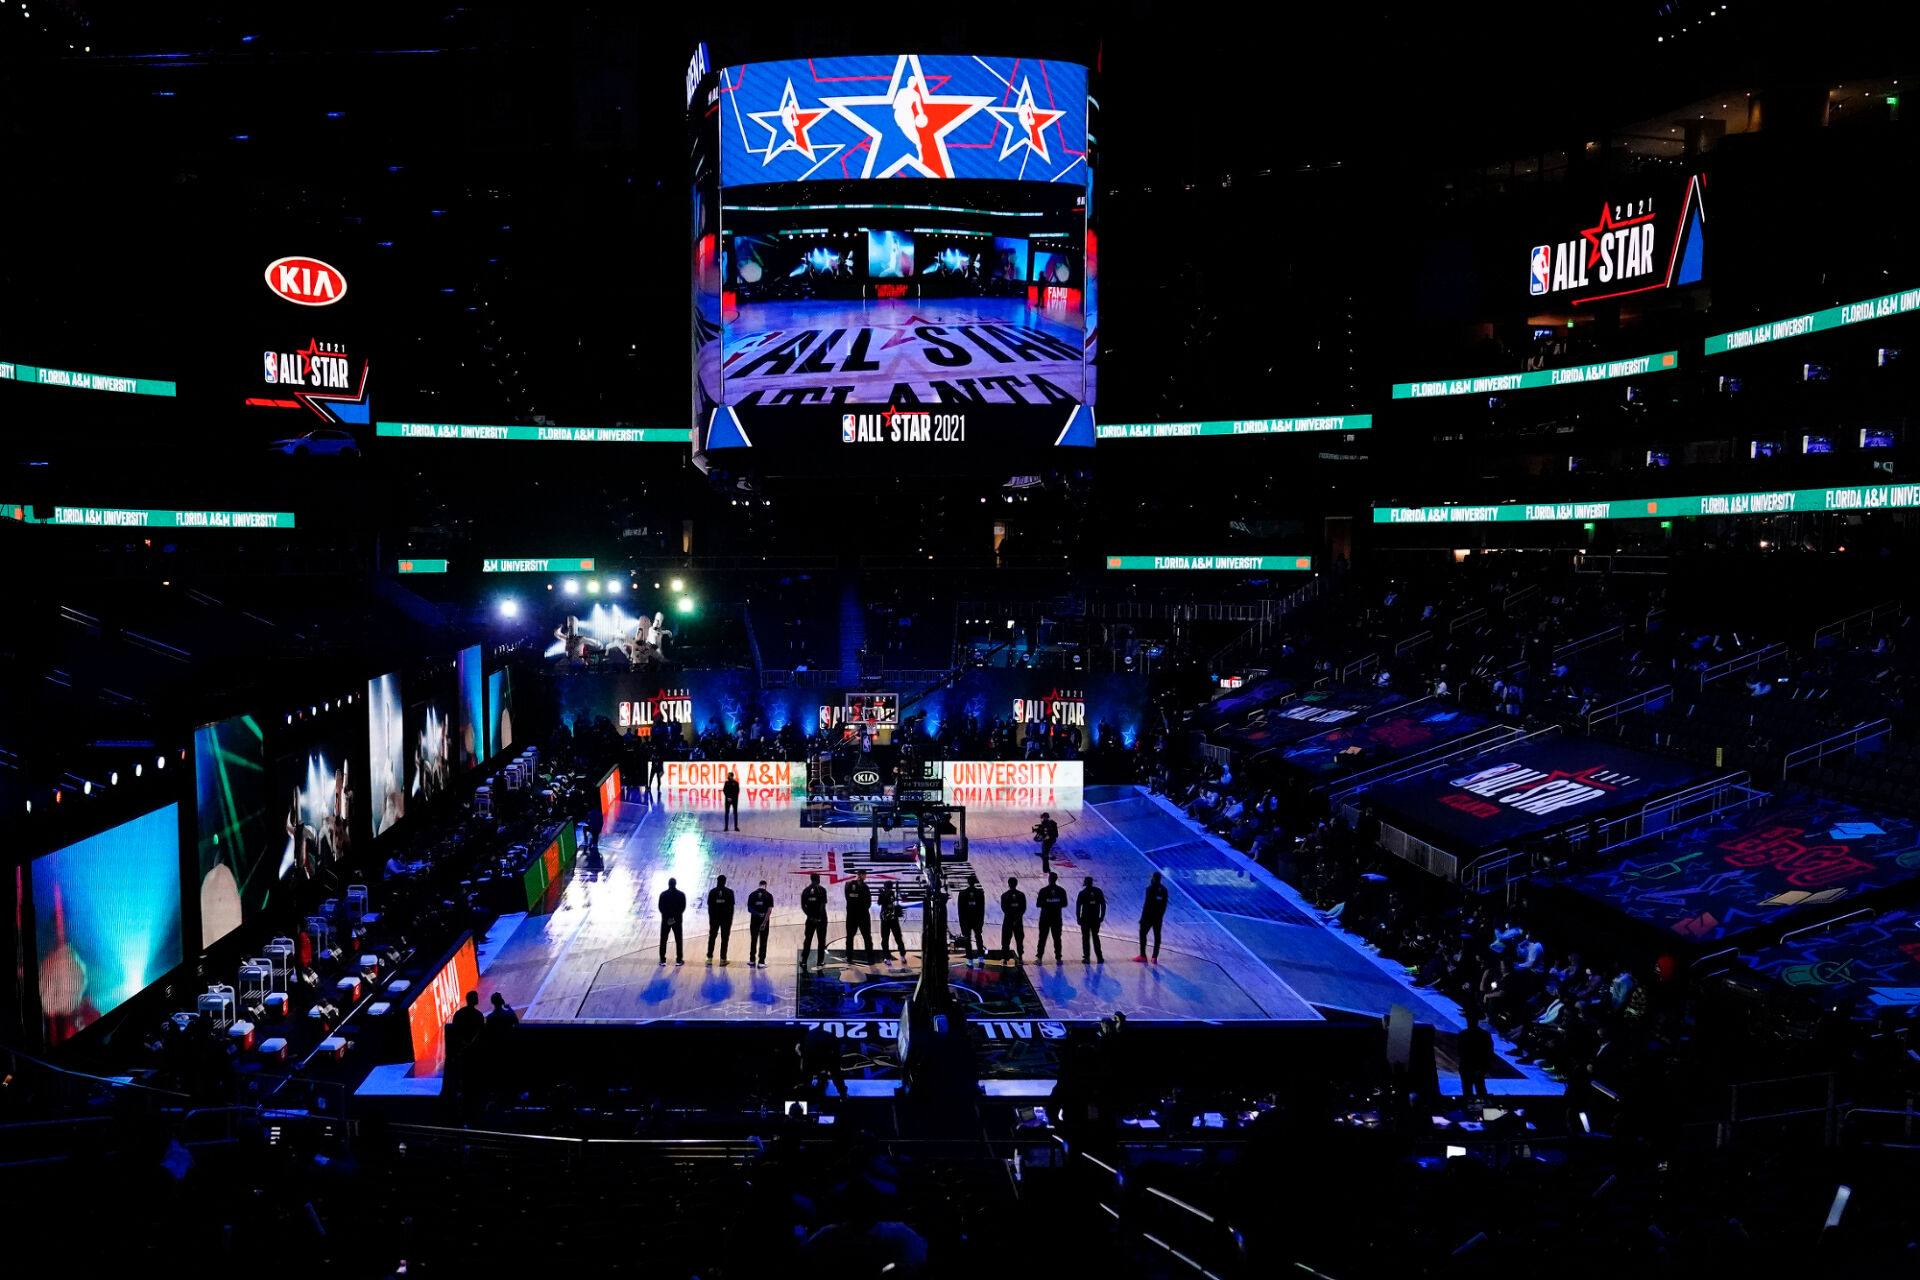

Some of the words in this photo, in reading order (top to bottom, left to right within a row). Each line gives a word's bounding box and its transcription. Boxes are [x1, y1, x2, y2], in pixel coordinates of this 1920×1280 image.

[1616, 198, 1652, 220] 2021
[1552, 237, 1588, 292] ALL
[1599, 223, 1655, 283] STAR
[279, 265, 335, 298] KIA
[1842, 302, 1874, 323] FLORIDA
[1877, 295, 1898, 316] A&M
[1727, 330, 1753, 349] FLORIDA
[1754, 325, 1771, 344] A&M
[1773, 315, 1814, 340] UNIVERSITY
[319, 342, 345, 353] 2021
[723, 328, 880, 380] ALL
[915, 325, 1083, 368] STAR
[40, 369, 70, 386] FLORIDA
[72, 373, 91, 388] A&M
[92, 376, 137, 393] UNIVERSITY
[280, 353, 305, 385] ALL
[311, 356, 349, 388] STAR
[1552, 368, 1584, 384] FLORIDA
[1586, 365, 1606, 381] A&M
[1609, 358, 1650, 376] UNIVERSITY
[1411, 383, 1448, 397] FLORIDA
[1449, 380, 1472, 394] A&M
[1474, 375, 1522, 391] UNIVERSITY
[401, 424, 436, 437] FLORIDA
[437, 426, 459, 438] A&M
[461, 426, 508, 439] UNIVERSITY
[538, 428, 572, 440] FLORIDA
[574, 429, 595, 440] A&M
[597, 429, 645, 441] UNIVERSITY
[858, 414, 884, 442] ALL
[891, 414, 931, 442] STAR
[934, 414, 965, 442] 2021
[1129, 425, 1151, 437] A&M
[1153, 424, 1202, 437] UNIVERSITY
[1233, 420, 1269, 434] FLORIDA
[1271, 420, 1293, 432] A&M
[1295, 417, 1344, 431] UNIVERSITY
[1701, 497, 1729, 514] FLORIDA
[1731, 495, 1749, 513] A&M
[1751, 493, 1796, 512] UNIVERSITY
[1825, 490, 1862, 508] FLORIDA
[1864, 488, 1888, 507] A&M
[55, 508, 84, 524] FLORIDA
[85, 509, 102, 525] A&M
[104, 511, 149, 526] UNIVERSITY
[176, 512, 208, 526] FLORIDA
[210, 513, 231, 527] A&M
[233, 513, 278, 528] UNIVERSITY
[1390, 508, 1426, 523] FLORIDA
[1428, 508, 1450, 522] A&M
[1451, 507, 1499, 521] UNIVERSITY
[1525, 505, 1554, 520] FLORIDA
[1554, 504, 1573, 519] A&M
[1574, 503, 1610, 519] UNIVERSITY
[501, 560, 549, 572] UNIVERSITY
[1155, 557, 1190, 569] FLORIDA
[1191, 557, 1213, 569] A&M
[1216, 557, 1263, 569] UNIVERSITY
[667, 688, 690, 696] 2021
[632, 701, 653, 725] ALL
[660, 700, 692, 723] STAR
[1052, 701, 1085, 726] STAR
[746, 764, 791, 785] A&M
[953, 763, 1057, 785] UNIVERSITY
[1463, 768, 1549, 797] ALL
[1499, 780, 1606, 816] STAR
[433, 956, 460, 1028] FAMU
